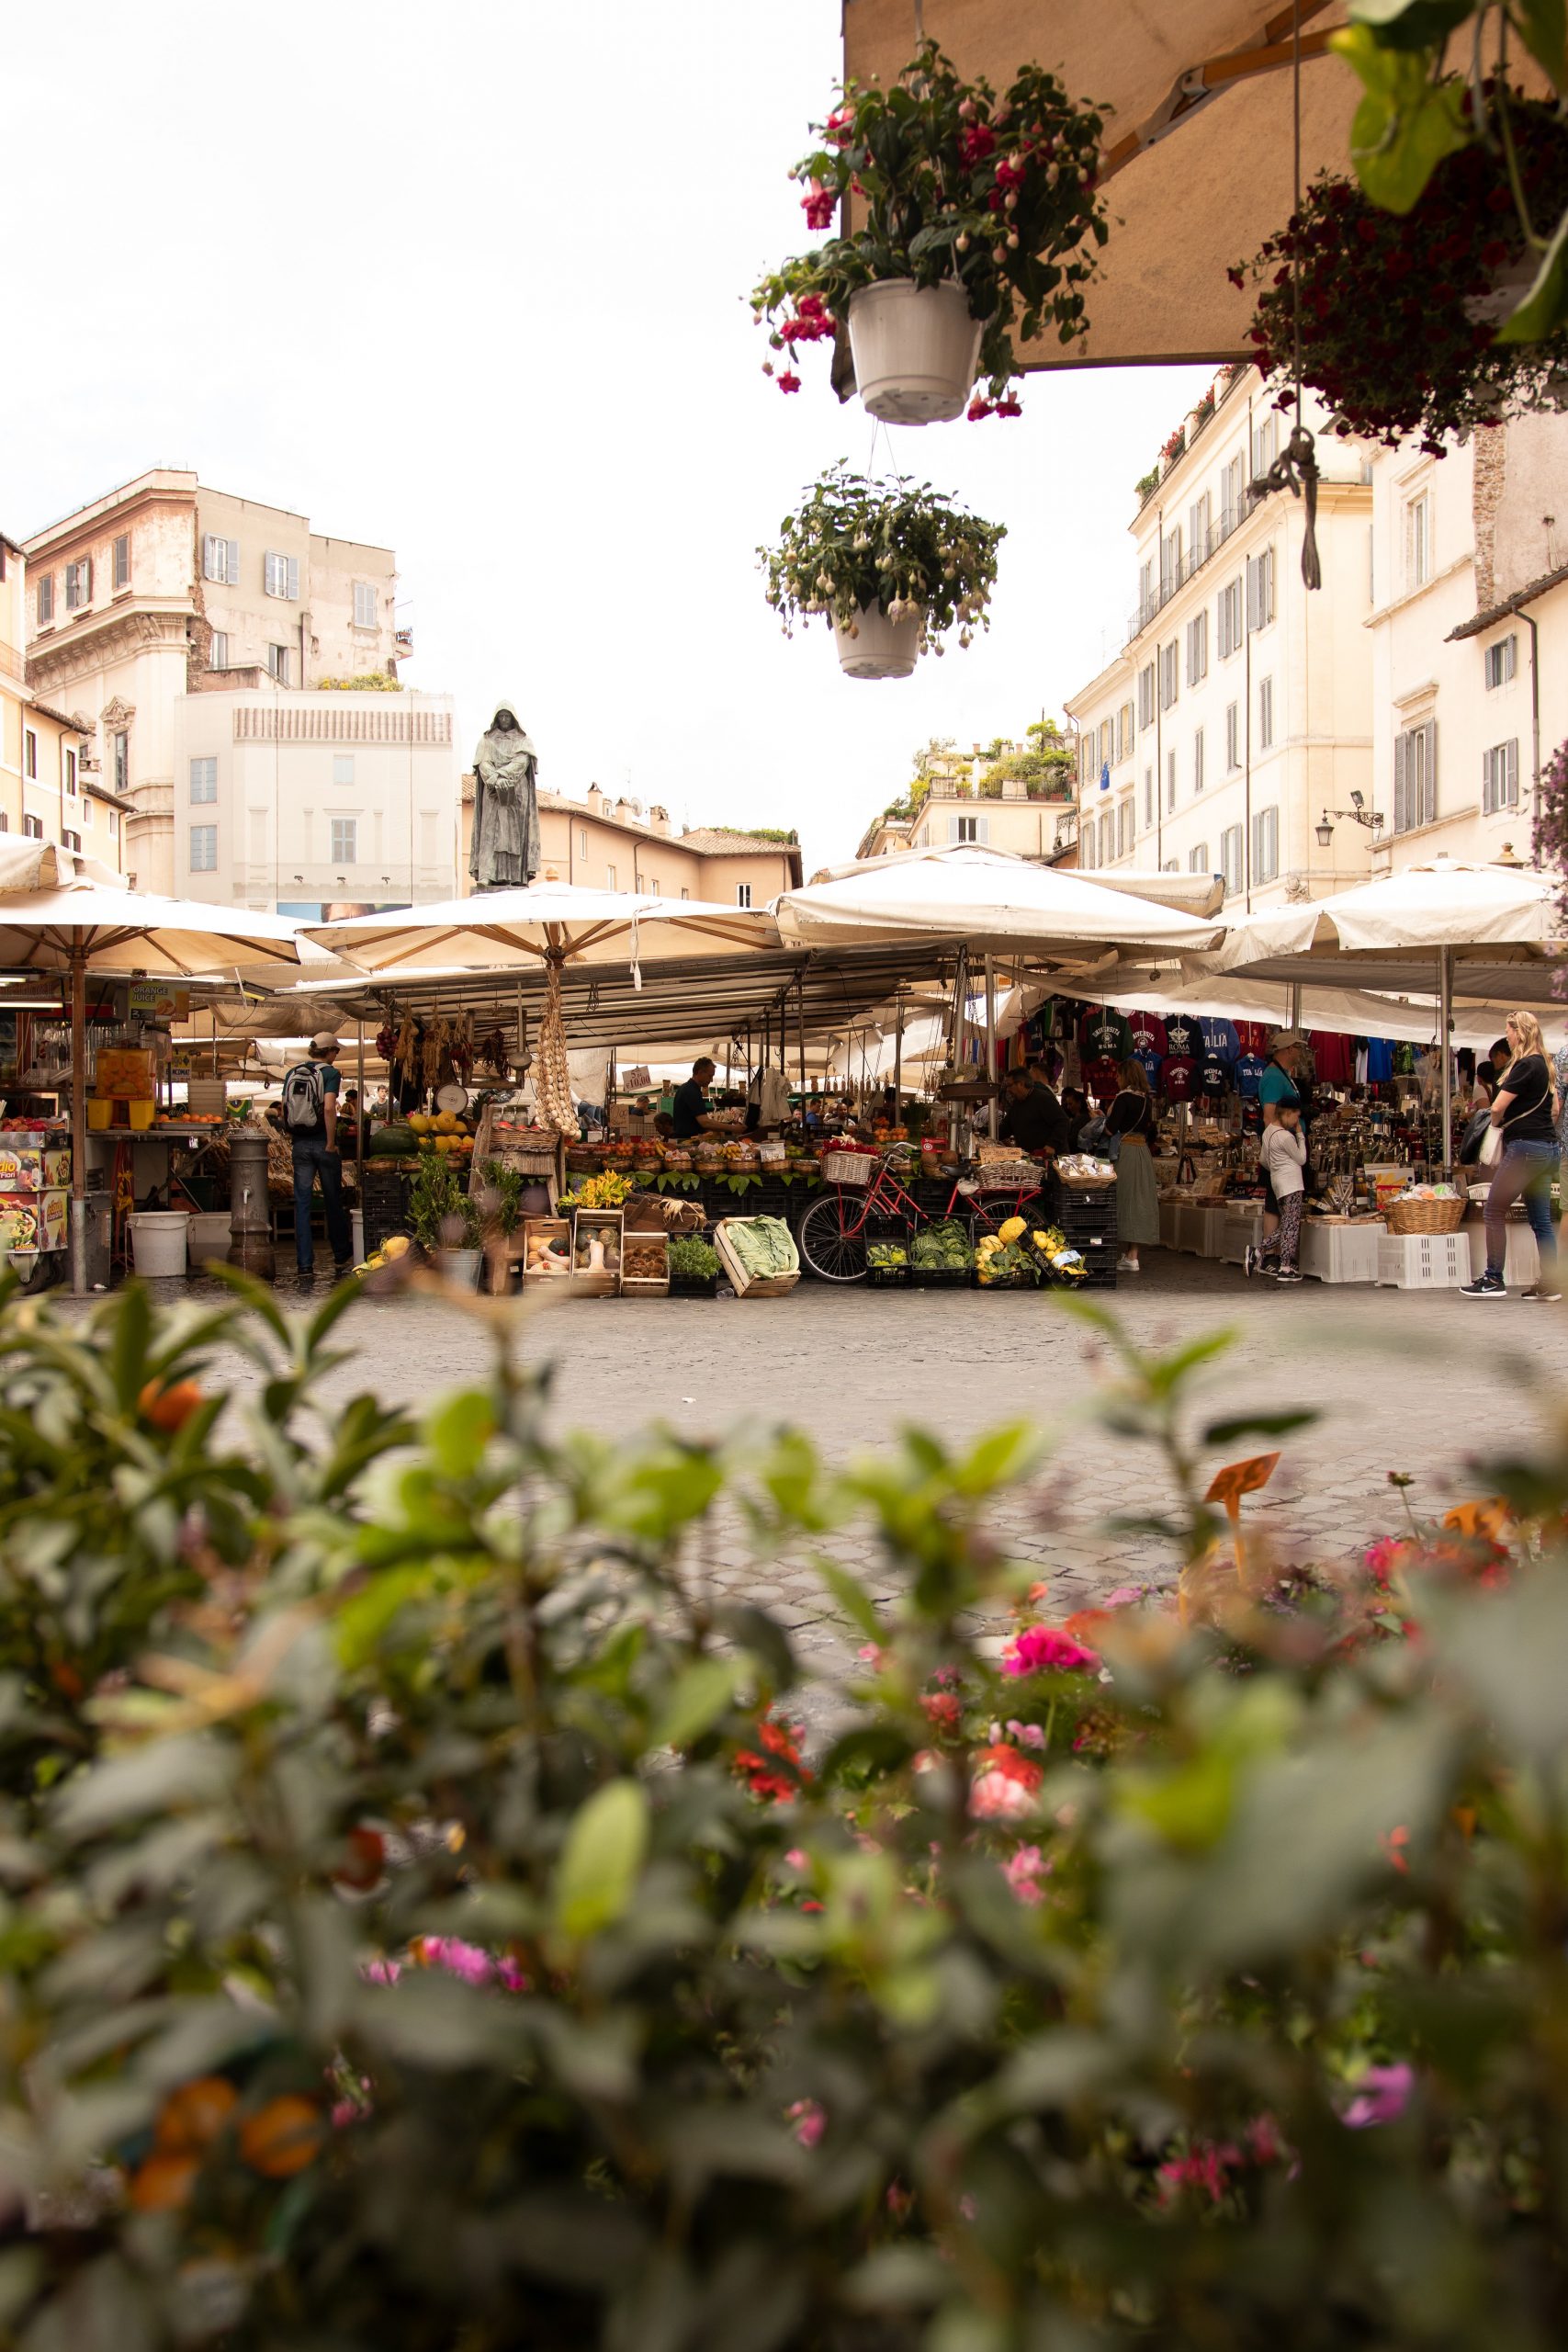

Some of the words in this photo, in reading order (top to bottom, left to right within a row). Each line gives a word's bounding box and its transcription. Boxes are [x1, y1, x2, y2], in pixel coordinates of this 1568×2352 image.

[133, 986, 168, 994] ORANGE
[133, 994, 155, 1002] JUICE
[1203, 1033, 1228, 1048] ALIA
[1203, 1068, 1223, 1077] ROMA
